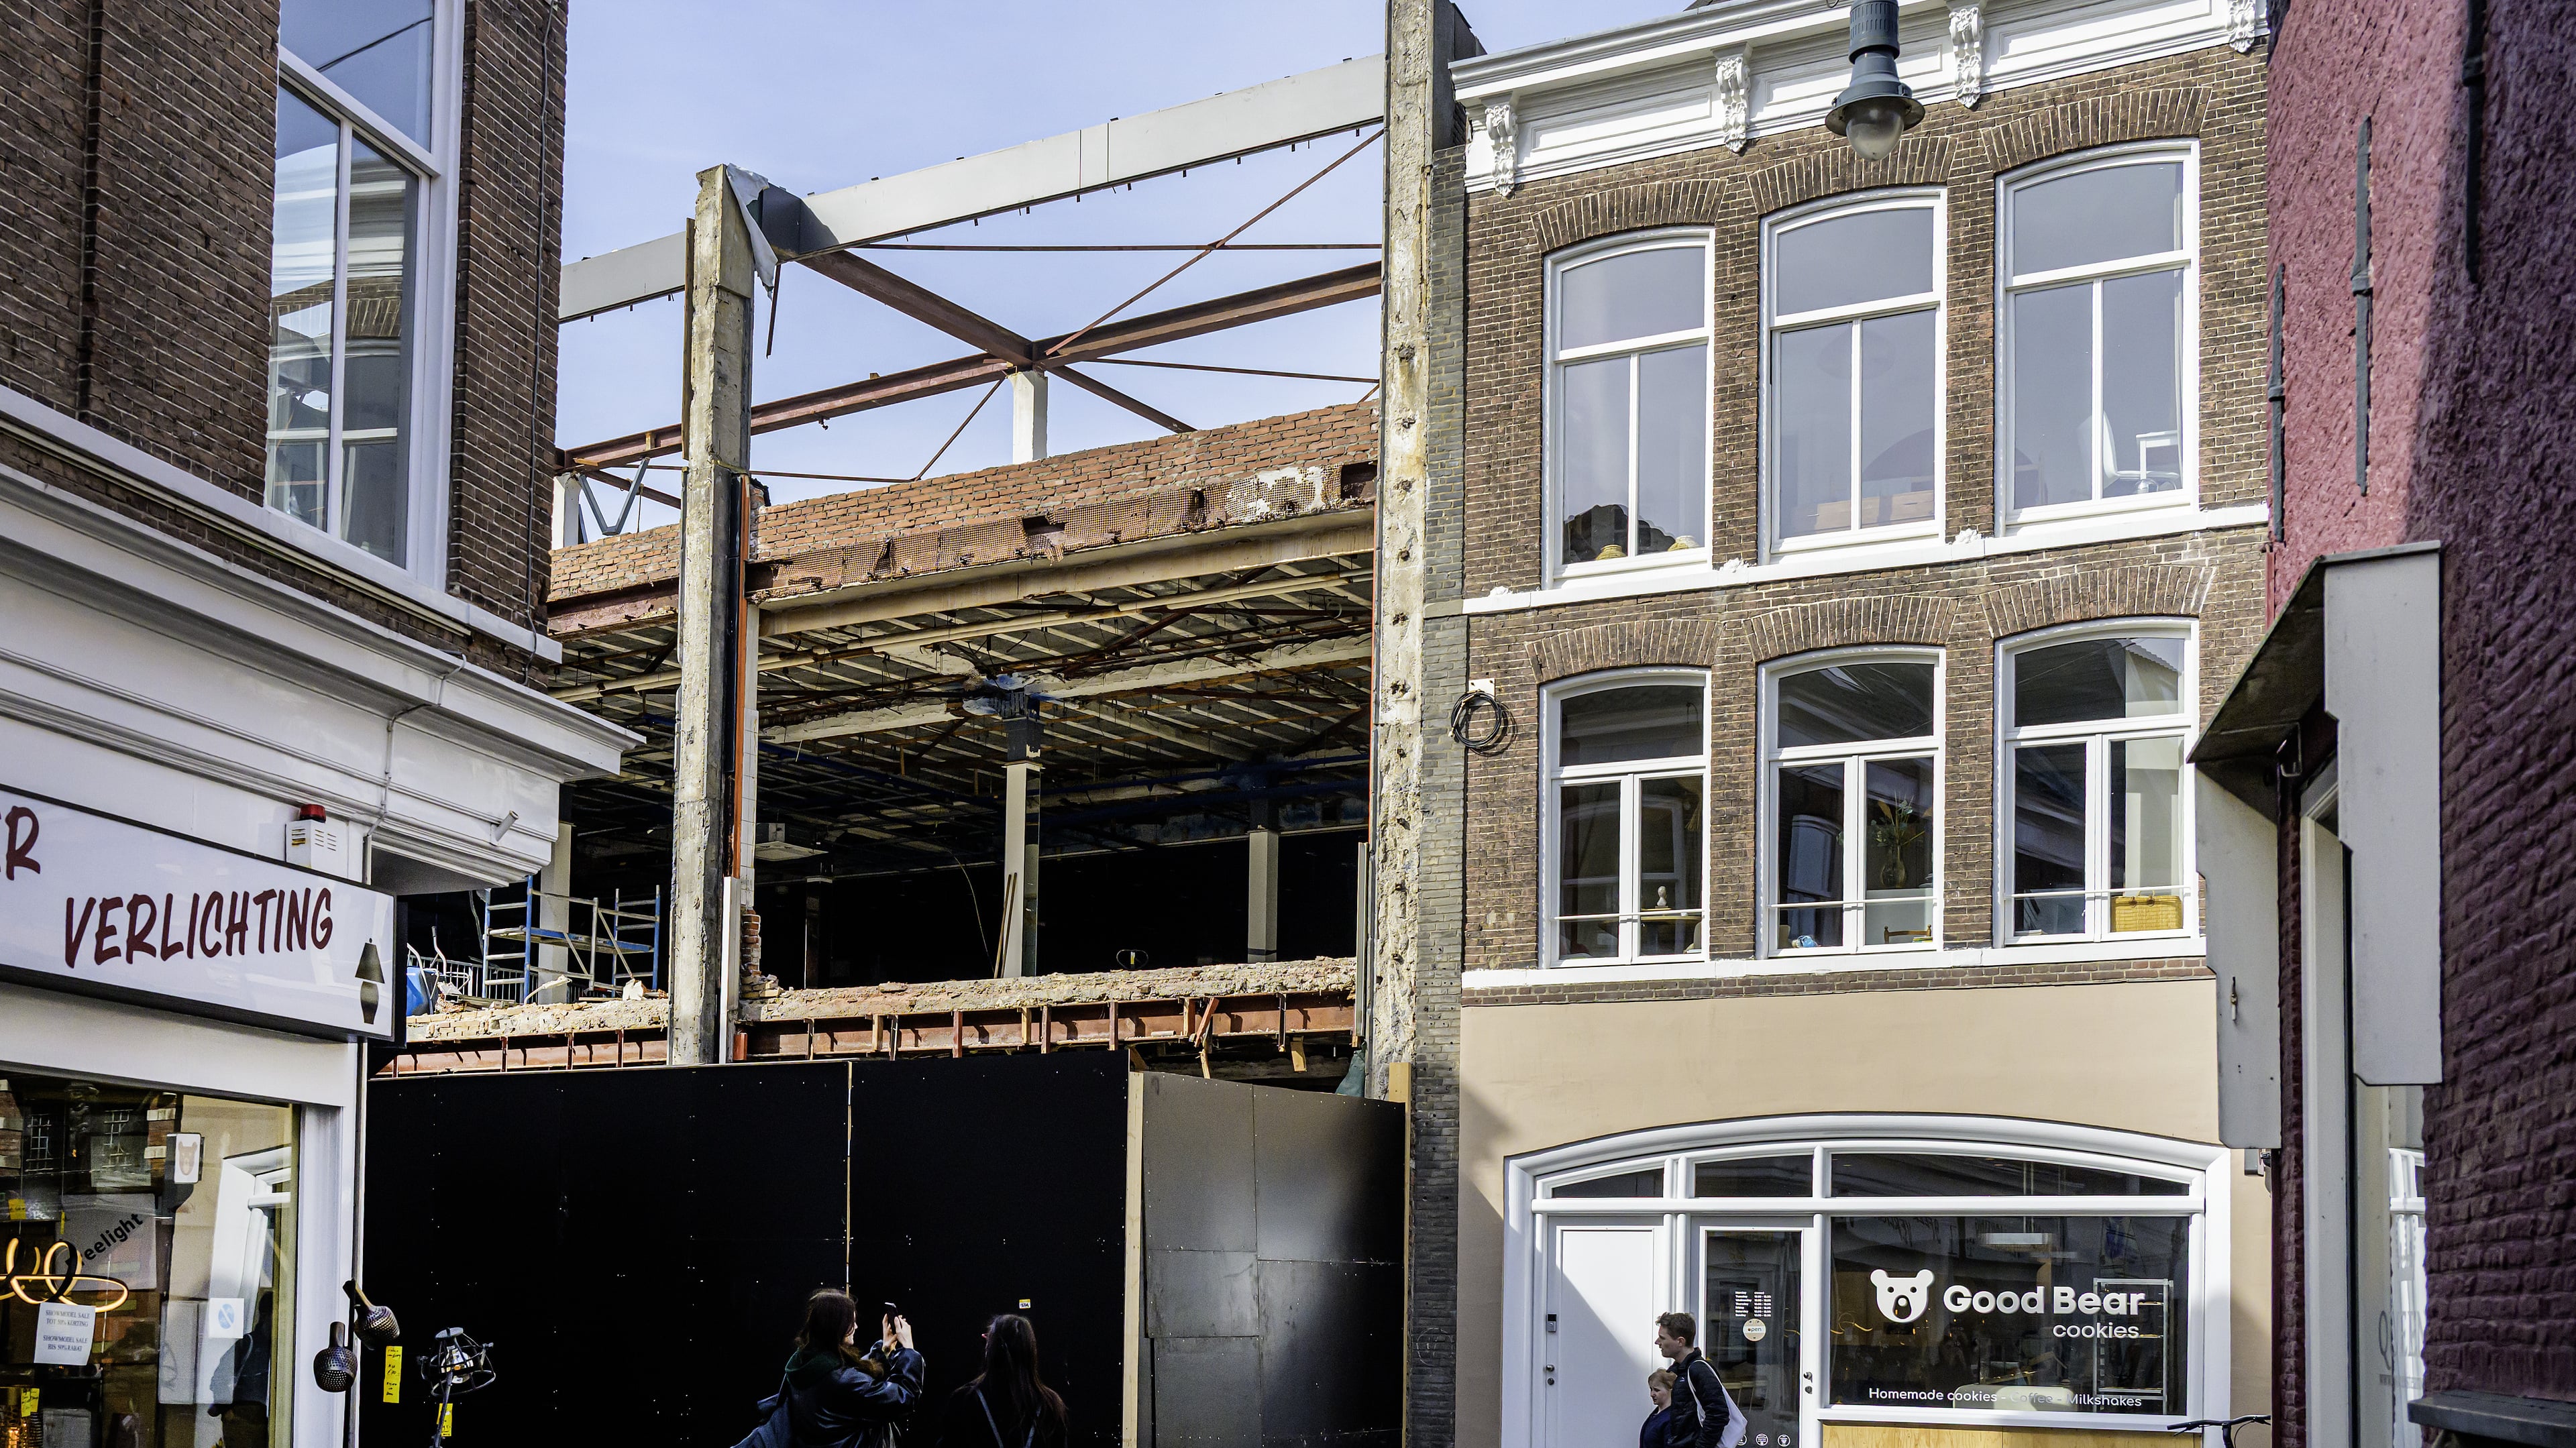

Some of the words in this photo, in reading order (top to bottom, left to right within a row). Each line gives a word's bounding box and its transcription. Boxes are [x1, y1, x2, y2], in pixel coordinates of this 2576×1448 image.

[0, 805, 40, 881] R
[65, 888, 333, 968] VERLICHTING
[65, 1213, 144, 1269] eelight
[46, 1310, 76, 1318] SHOWMODEL
[1943, 1285, 2045, 1313] Good
[2053, 1286, 2145, 1315] Bear
[2053, 1322, 2140, 1339] cookies
[1869, 1388, 1943, 1400] Homemade
[1947, 1390, 1997, 1402] cookies
[2010, 1392, 2053, 1404] Coffee
[2067, 1394, 2142, 1407] Milkshakes
